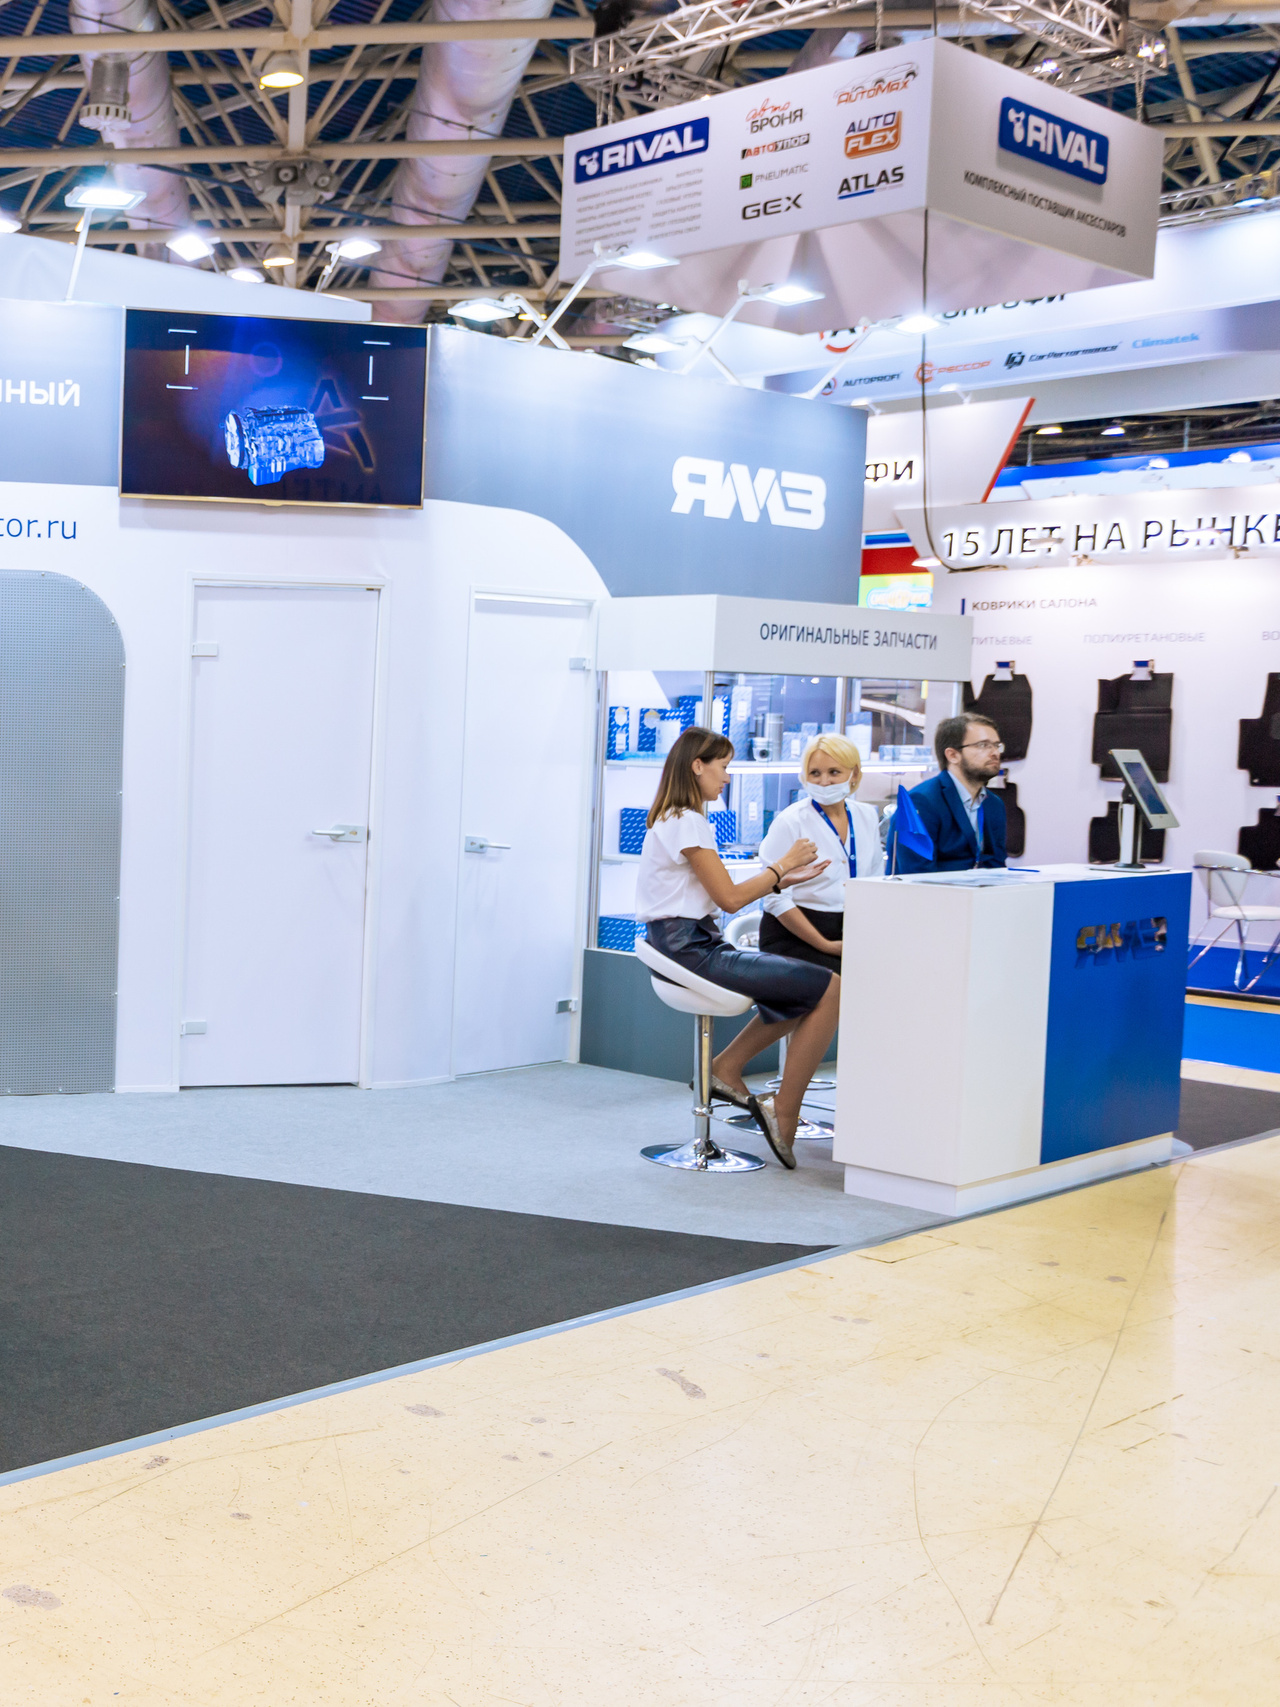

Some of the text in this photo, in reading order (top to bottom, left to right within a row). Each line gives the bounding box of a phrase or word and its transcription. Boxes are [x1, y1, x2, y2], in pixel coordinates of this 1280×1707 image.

[750, 108, 803, 134] БРОНЯ
[846, 112, 897, 135] AUTO
[601, 125, 706, 173] RIVAL
[846, 128, 898, 154] FLEX
[1026, 114, 1105, 175] RIVAL
[754, 163, 809, 182] PNEUMATIC
[838, 166, 905, 195] ATLAS
[742, 193, 803, 220] GEX
[1131, 332, 1200, 349] Climatek
[842, 372, 902, 387] AUTOPROFI
[671, 456, 827, 530] ЯМЗ
[943, 531, 979, 557] 15
[991, 526, 1061, 555] ЛЕТ
[1074, 522, 1126, 551] НА
[972, 598, 1097, 611] КОВРИКИ САЛОНА
[760, 623, 938, 650] ОРИГИНАЛЬНЫЕ ЗАПЧАСТИ
[1083, 632, 1206, 644] ПОЛИУРЕТАНОВЫЕ
